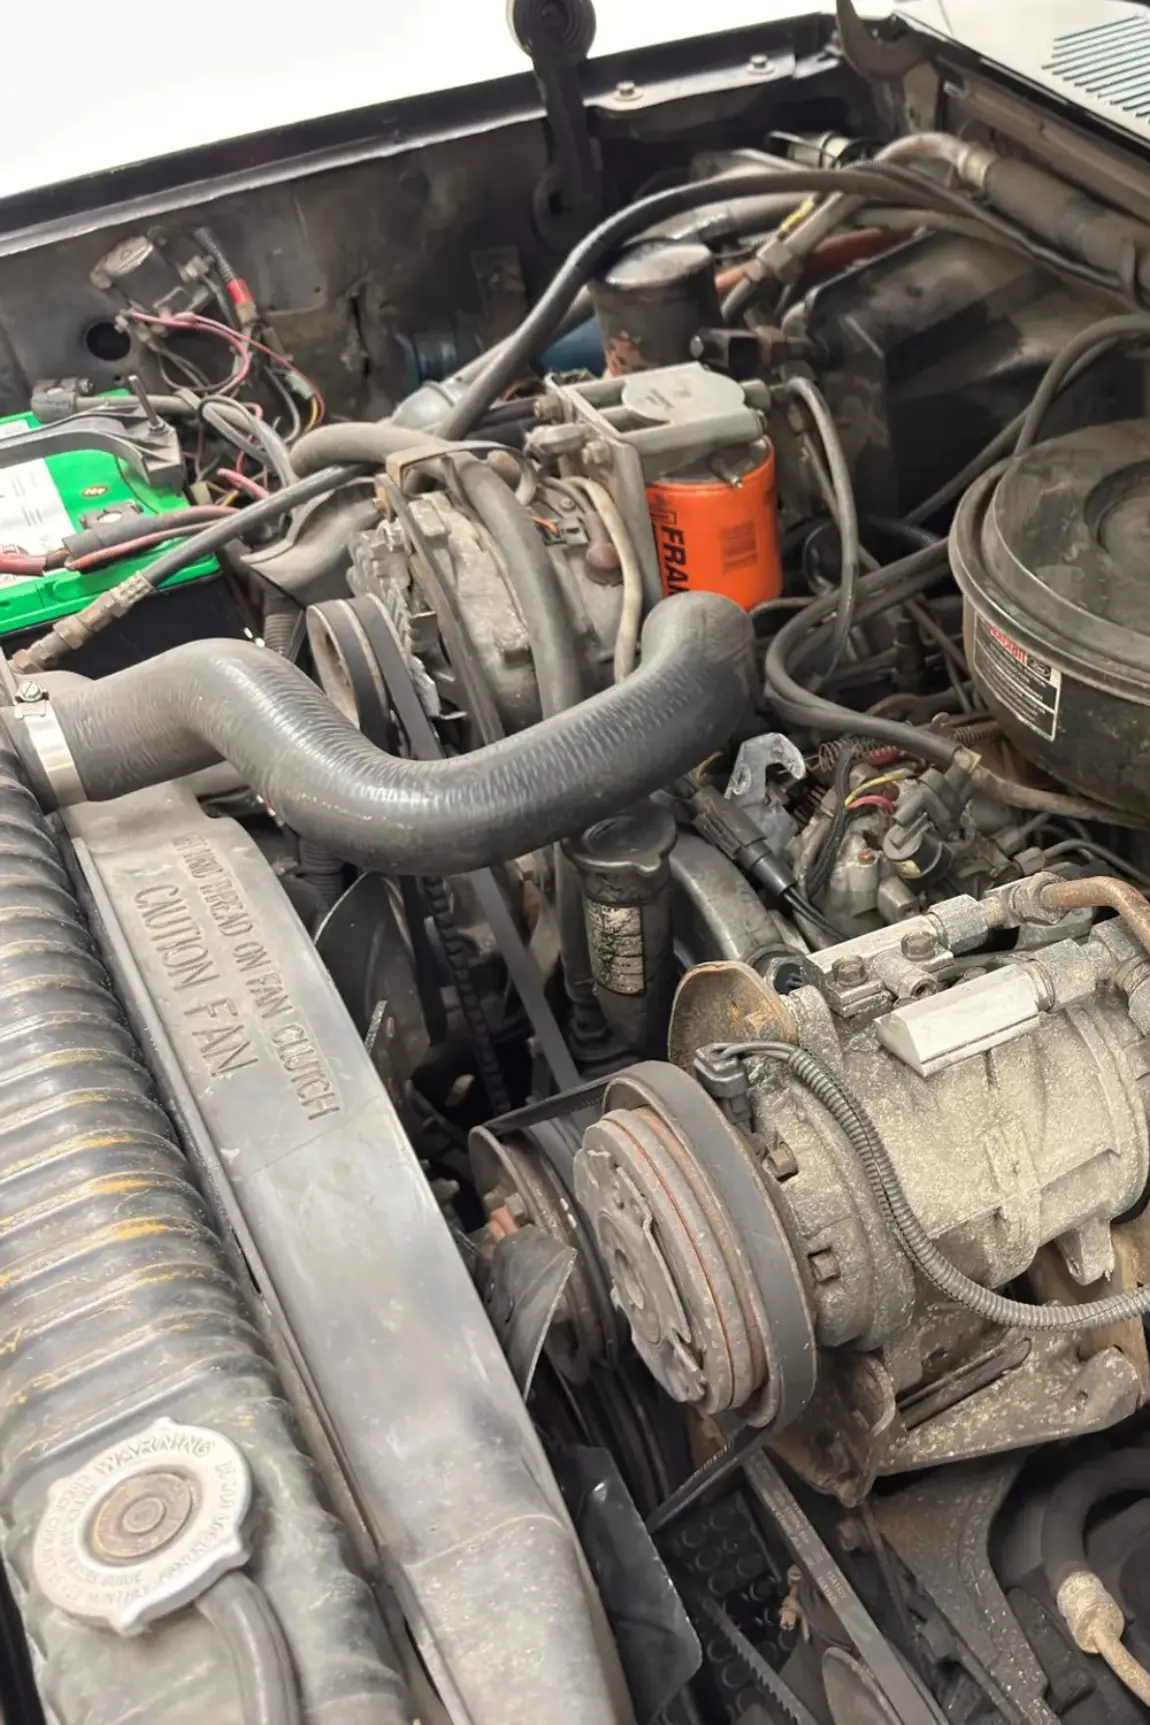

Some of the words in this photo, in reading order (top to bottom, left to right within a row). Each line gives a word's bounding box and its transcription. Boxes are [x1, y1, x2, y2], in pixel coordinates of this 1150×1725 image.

[134, 884, 220, 991] CAUTION
[184, 997, 259, 1077] FAN
[233, 941, 272, 973] ON
[245, 971, 294, 1019] FAN
[271, 1023, 341, 1121] CLUTCH
[94, 1436, 216, 1476] WARNING
